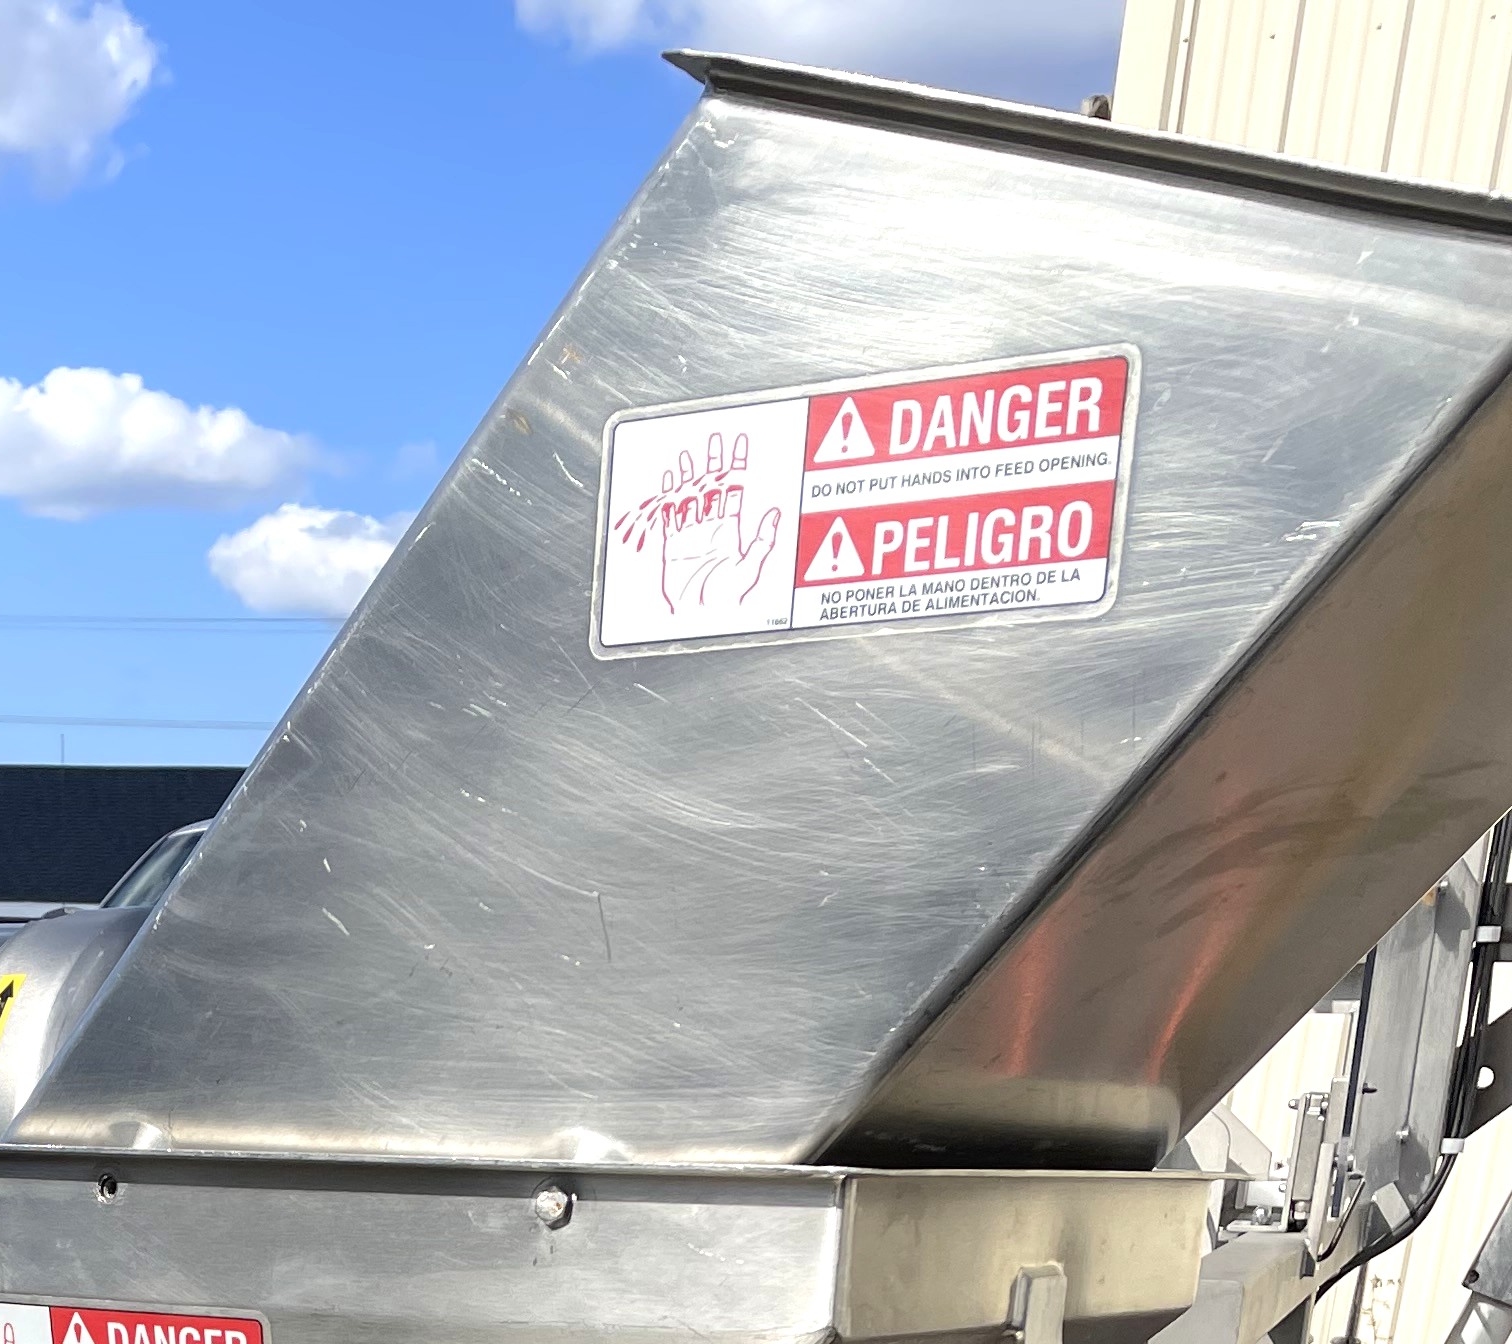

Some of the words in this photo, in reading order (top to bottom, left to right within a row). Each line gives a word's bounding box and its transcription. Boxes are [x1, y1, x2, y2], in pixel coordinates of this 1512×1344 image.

[889, 377, 1103, 456] DANGER
[811, 483, 831, 497] DO
[836, 479, 864, 494] NOT
[870, 476, 895, 491] PUT
[901, 469, 951, 487] HANDS
[956, 465, 990, 481] INTO
[995, 460, 1033, 477] FEED
[871, 500, 1093, 576] PELIGRO
[821, 591, 840, 604] NO
[846, 586, 893, 601] PONER
[899, 584, 916, 597] LA
[922, 579, 964, 594] MANO
[971, 573, 1031, 590] DENTRO
[1037, 571, 1056, 584] DE
[1061, 569, 1080, 582] LA
[820, 601, 896, 619] ABERTURA
[902, 599, 920, 612] DE
